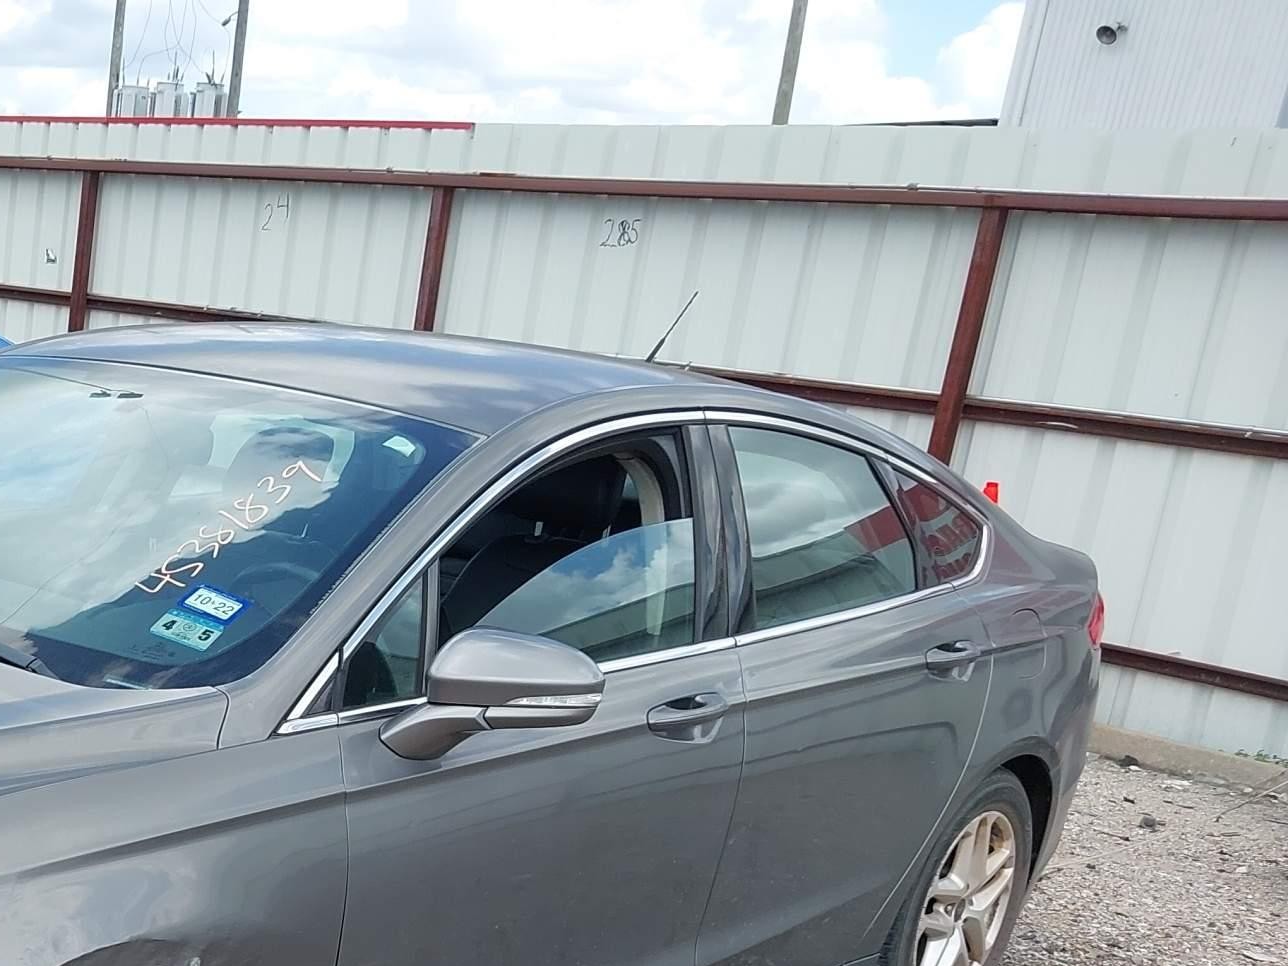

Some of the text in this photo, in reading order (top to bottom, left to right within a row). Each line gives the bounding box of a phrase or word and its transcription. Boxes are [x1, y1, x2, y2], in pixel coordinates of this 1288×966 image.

[262, 192, 289, 231] 24
[135, 460, 322, 593] 45381839
[162, 620, 177, 631] 4
[198, 629, 214, 641] 5
